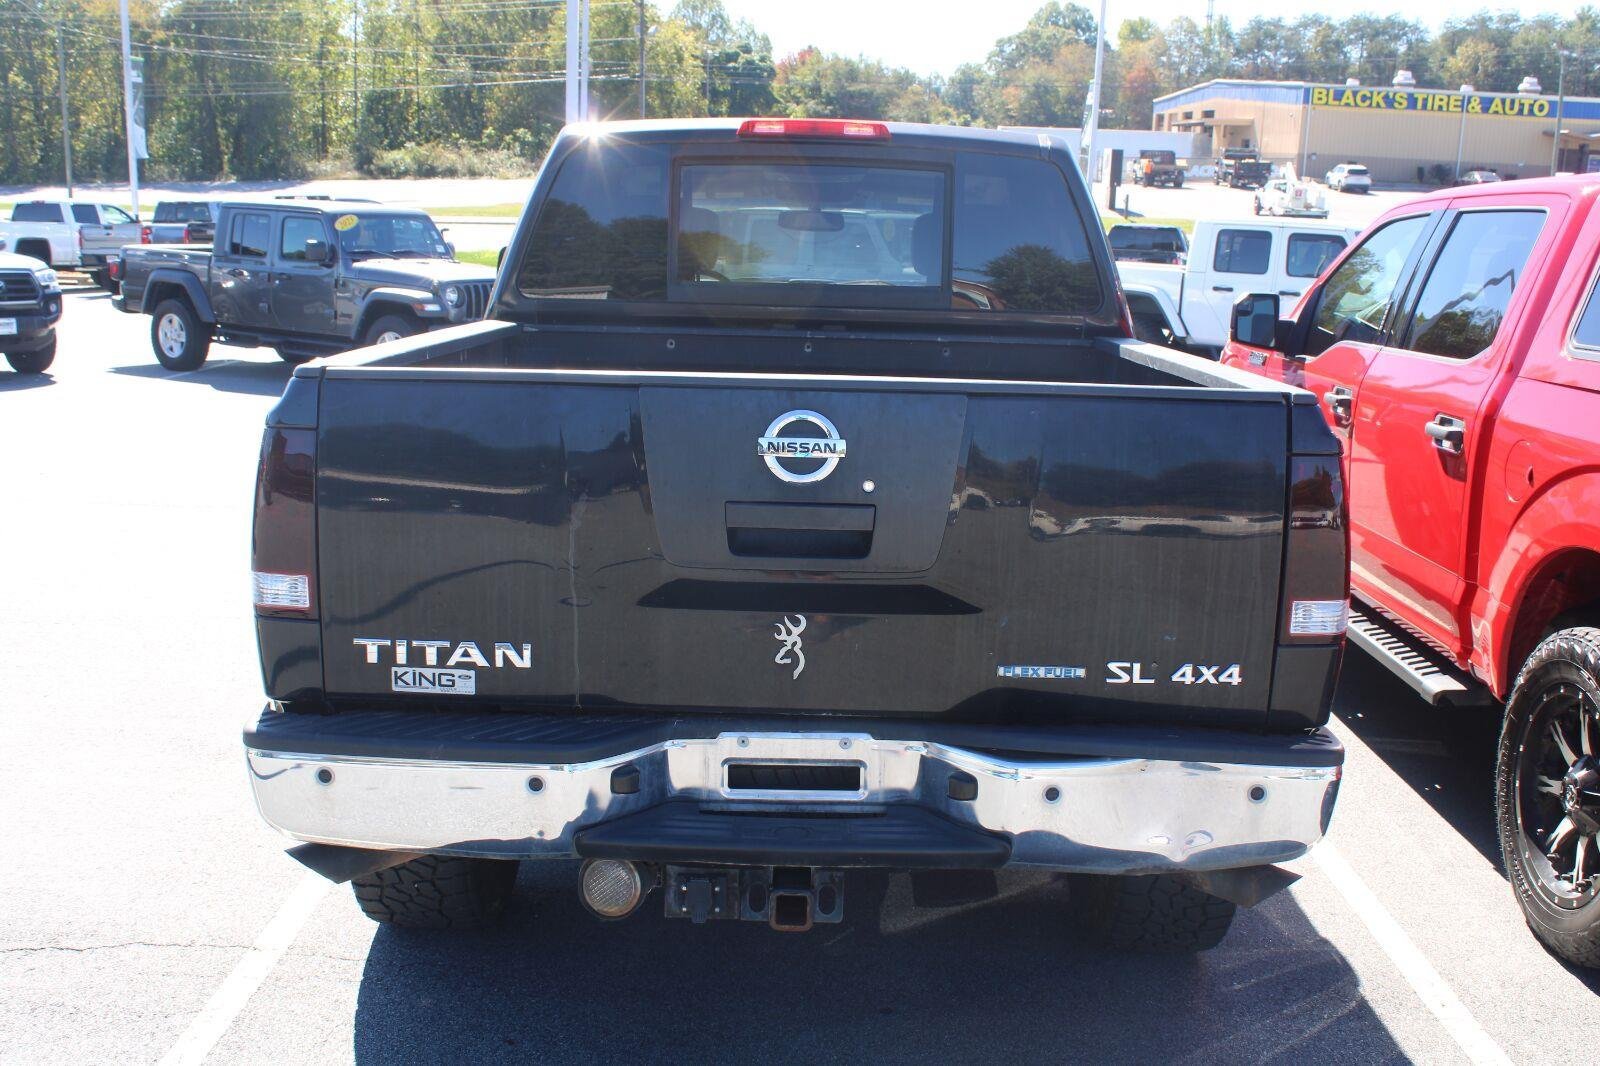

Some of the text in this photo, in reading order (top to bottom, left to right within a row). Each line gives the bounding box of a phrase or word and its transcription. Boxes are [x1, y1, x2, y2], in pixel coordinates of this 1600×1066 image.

[1312, 87, 1550, 117] BLACK'S TIRE & AUTO
[767, 441, 837, 453] NISSAN
[353, 638, 532, 668] TITAN
[1003, 666, 1084, 679] FLEX FUEL
[1106, 661, 1155, 684] SL
